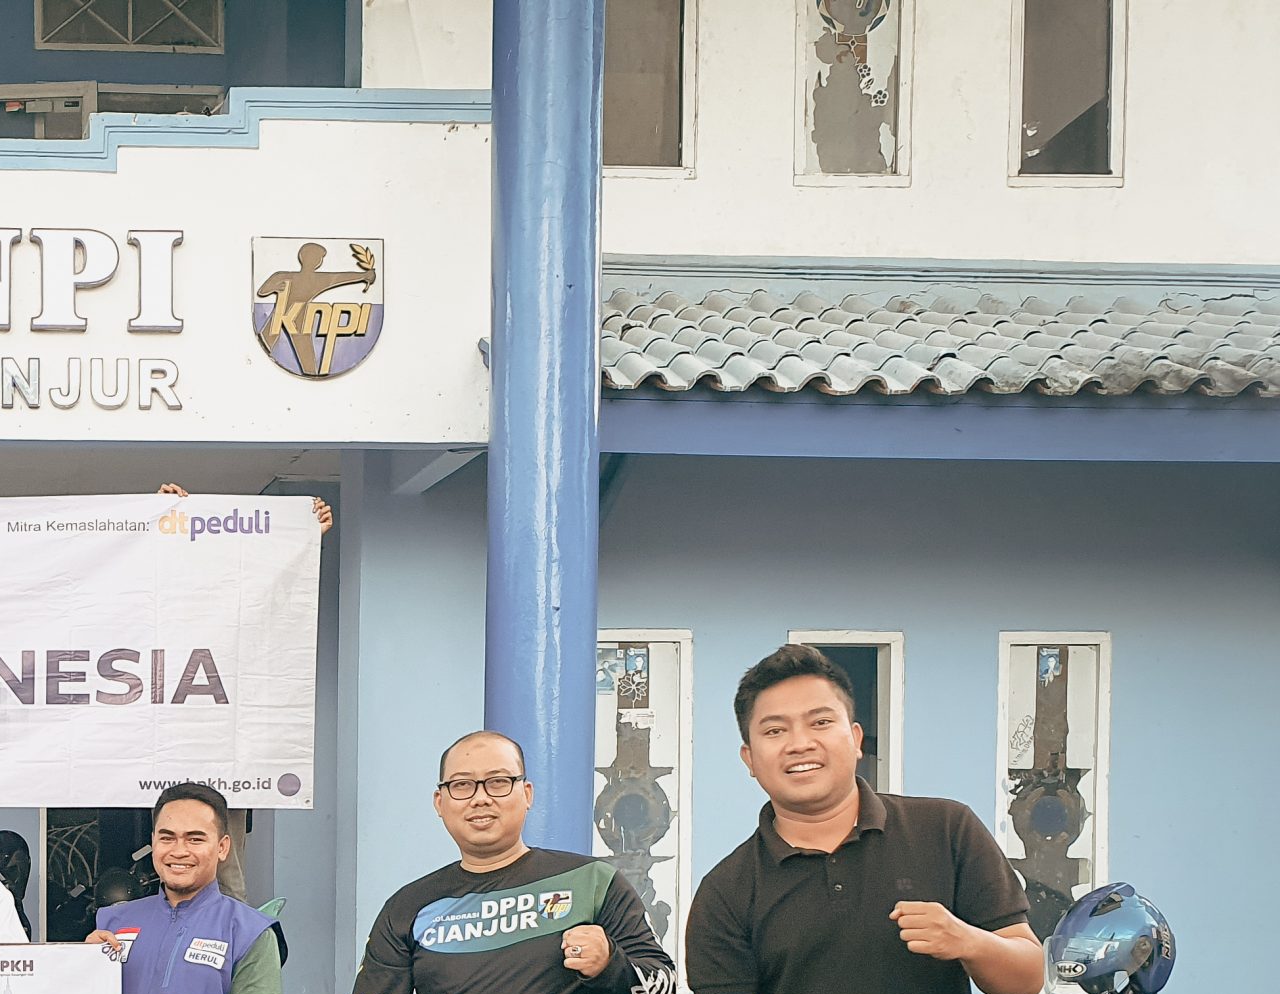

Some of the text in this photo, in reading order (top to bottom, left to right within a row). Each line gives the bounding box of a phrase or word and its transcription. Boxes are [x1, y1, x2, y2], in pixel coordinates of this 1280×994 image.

[270, 281, 372, 374] knpi
[7, 519, 150, 532] Mitra Kemaslahatan:
[158, 508, 271, 541] dtpeduli
[480, 893, 535, 919] DPD
[420, 911, 539, 947] CIANJUR
[188, 951, 219, 965] HERUL
[193, 940, 225, 952] dtpeduli
